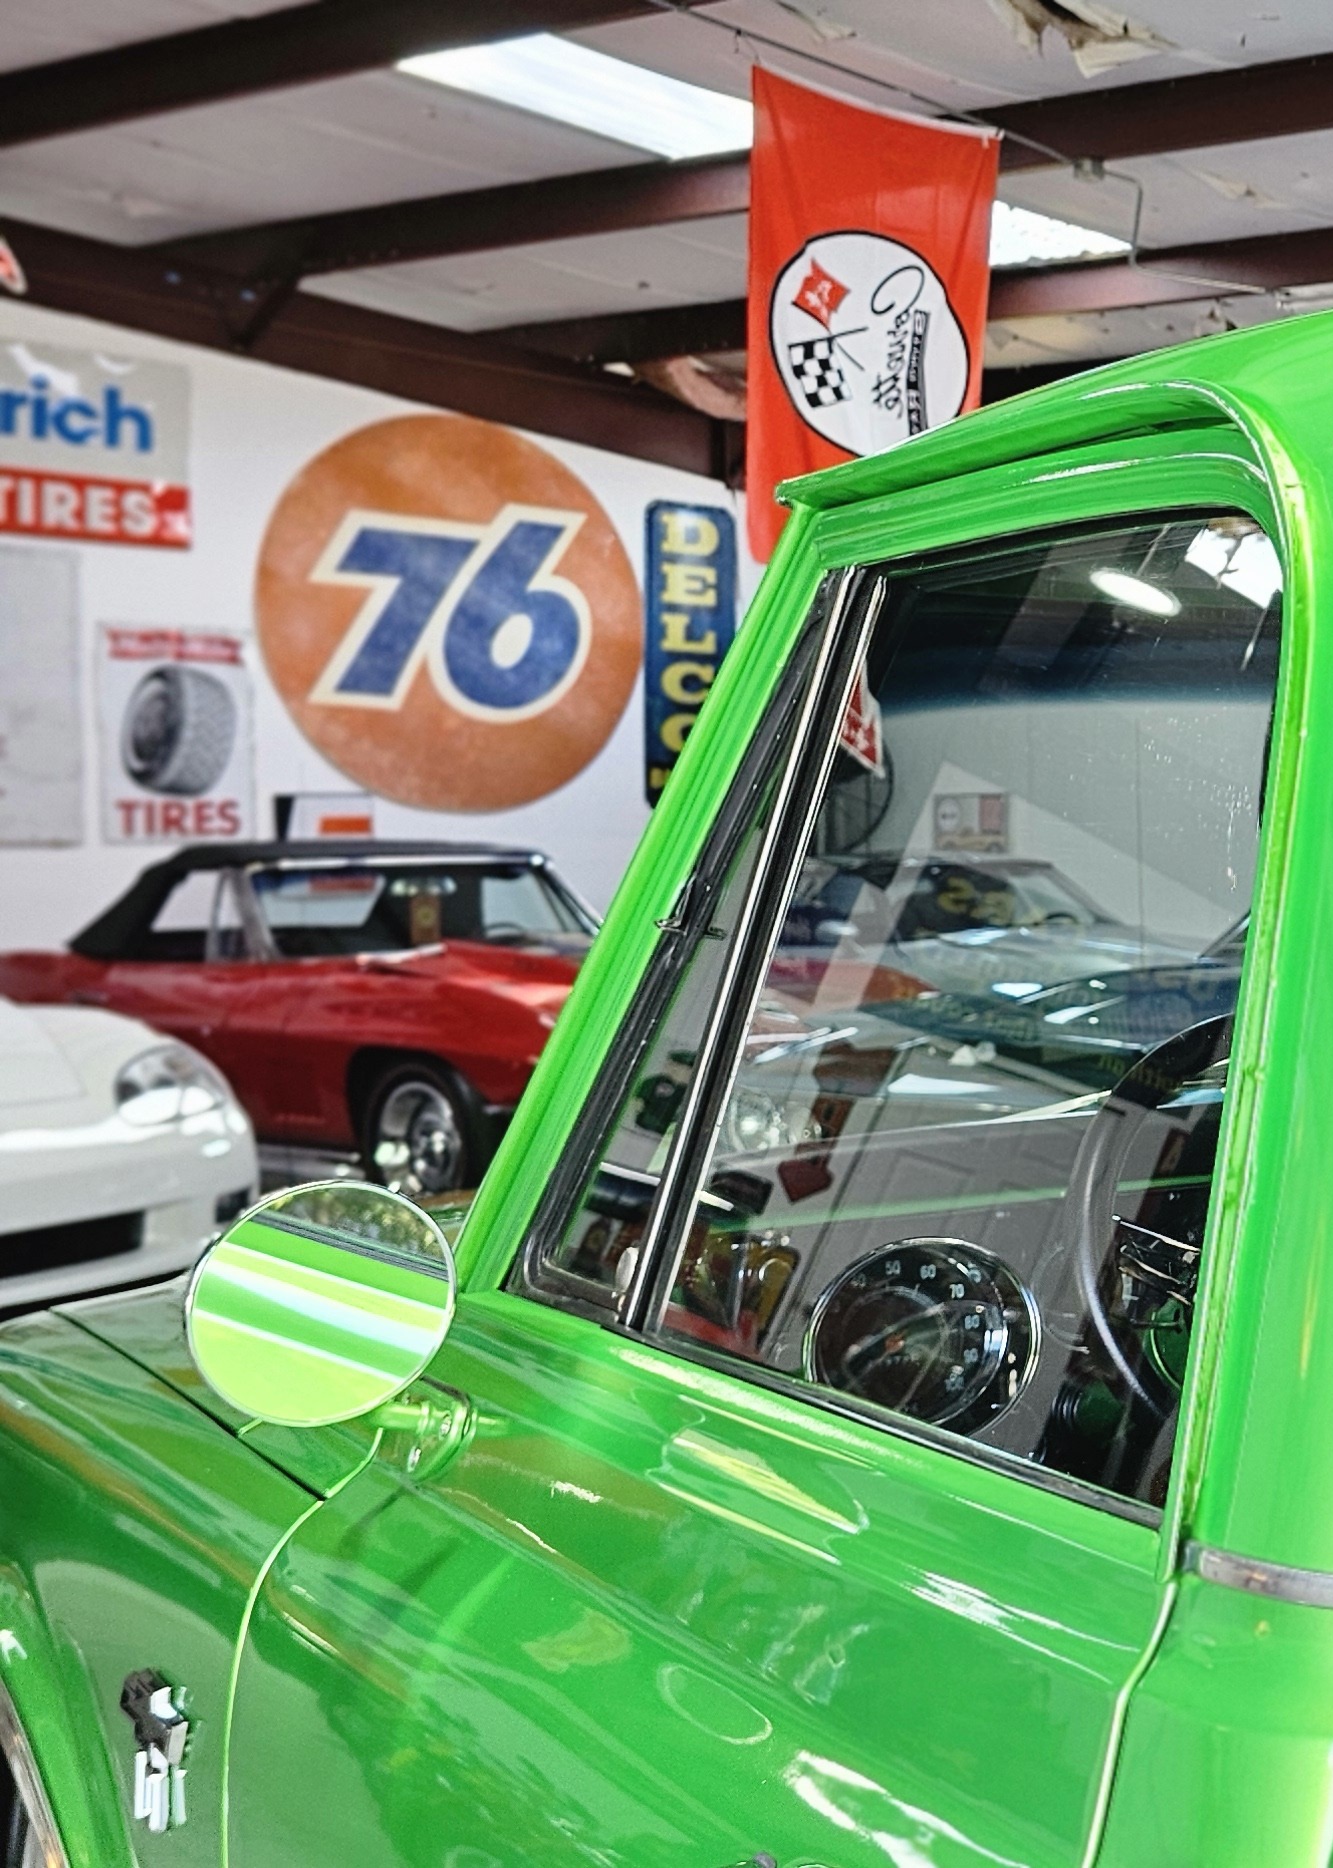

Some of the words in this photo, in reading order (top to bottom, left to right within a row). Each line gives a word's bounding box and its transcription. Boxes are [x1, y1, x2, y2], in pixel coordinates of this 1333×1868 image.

[308, 503, 591, 723] 76
[116, 799, 242, 838] TIRES
[884, 1259, 902, 1276] 50
[918, 1263, 937, 1280] 60
[948, 1282, 966, 1299] 70
